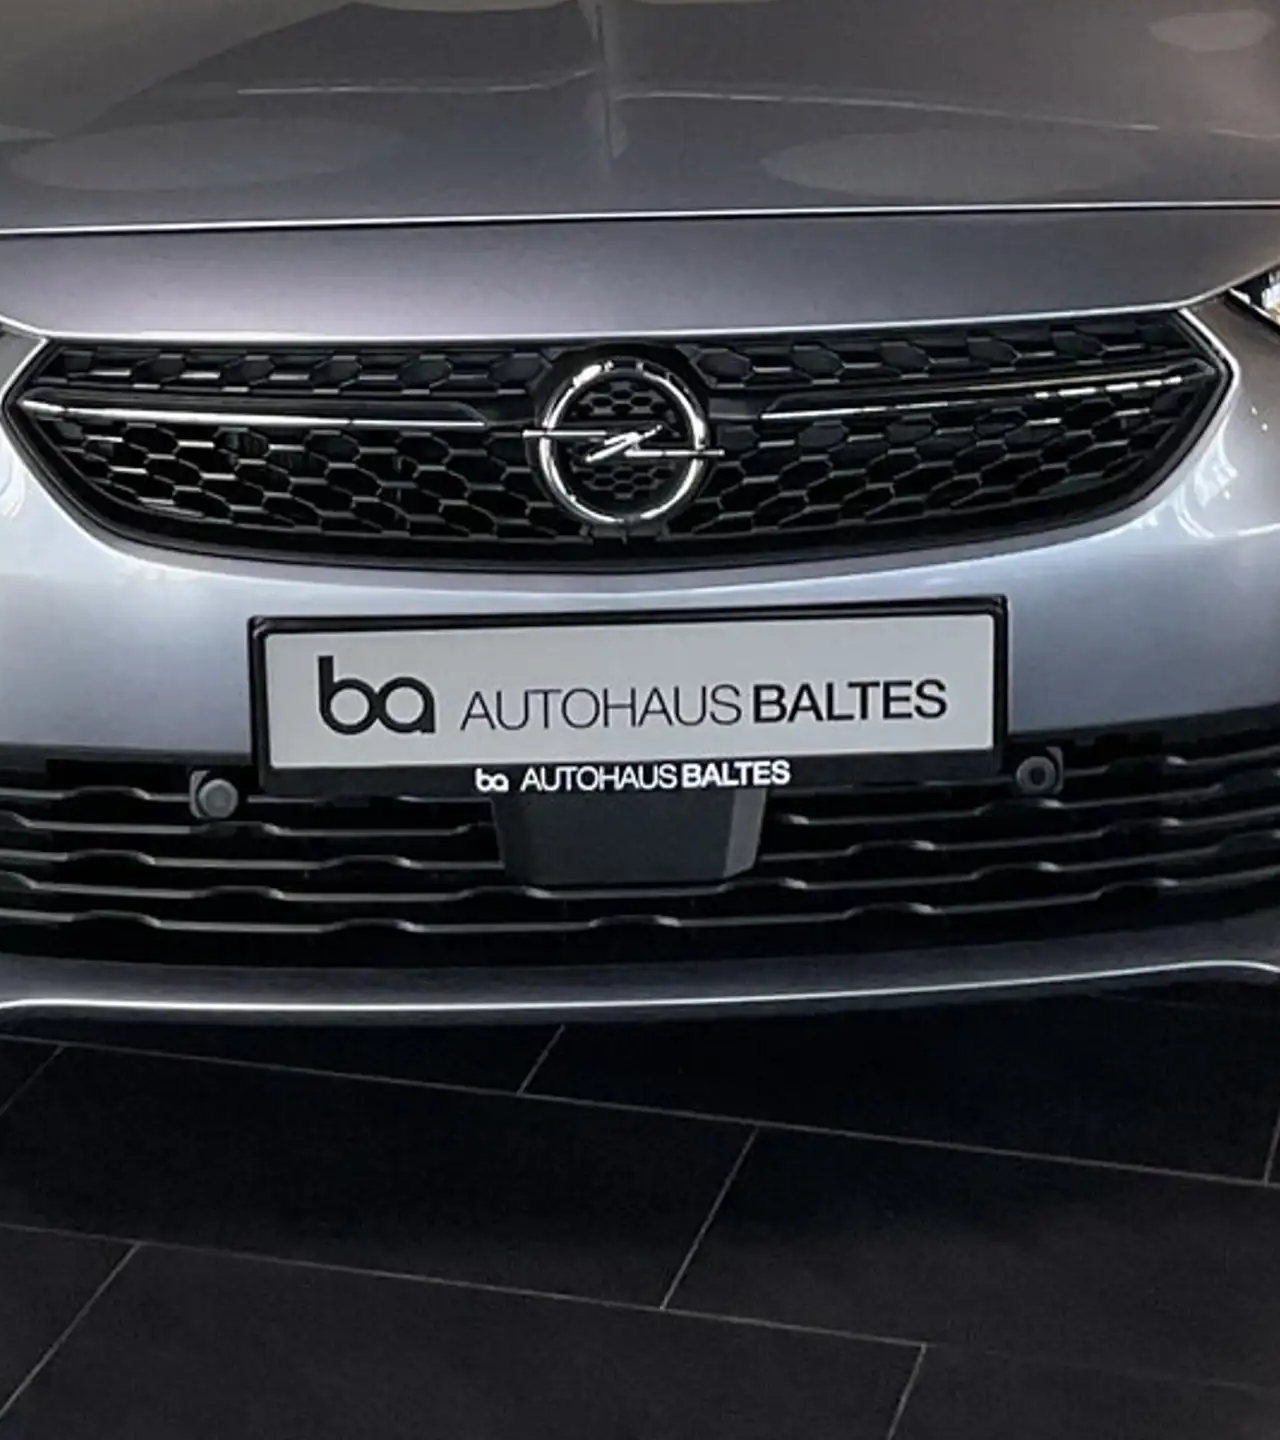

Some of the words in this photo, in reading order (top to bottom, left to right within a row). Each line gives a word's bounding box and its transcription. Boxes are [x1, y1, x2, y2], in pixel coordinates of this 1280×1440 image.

[318, 655, 436, 735] ba
[460, 683, 741, 732] AUTOHAUS
[752, 678, 948, 724] BALTES
[475, 768, 509, 792] ba
[520, 763, 677, 792] AUTOHAUS
[682, 759, 791, 789] BALTES
